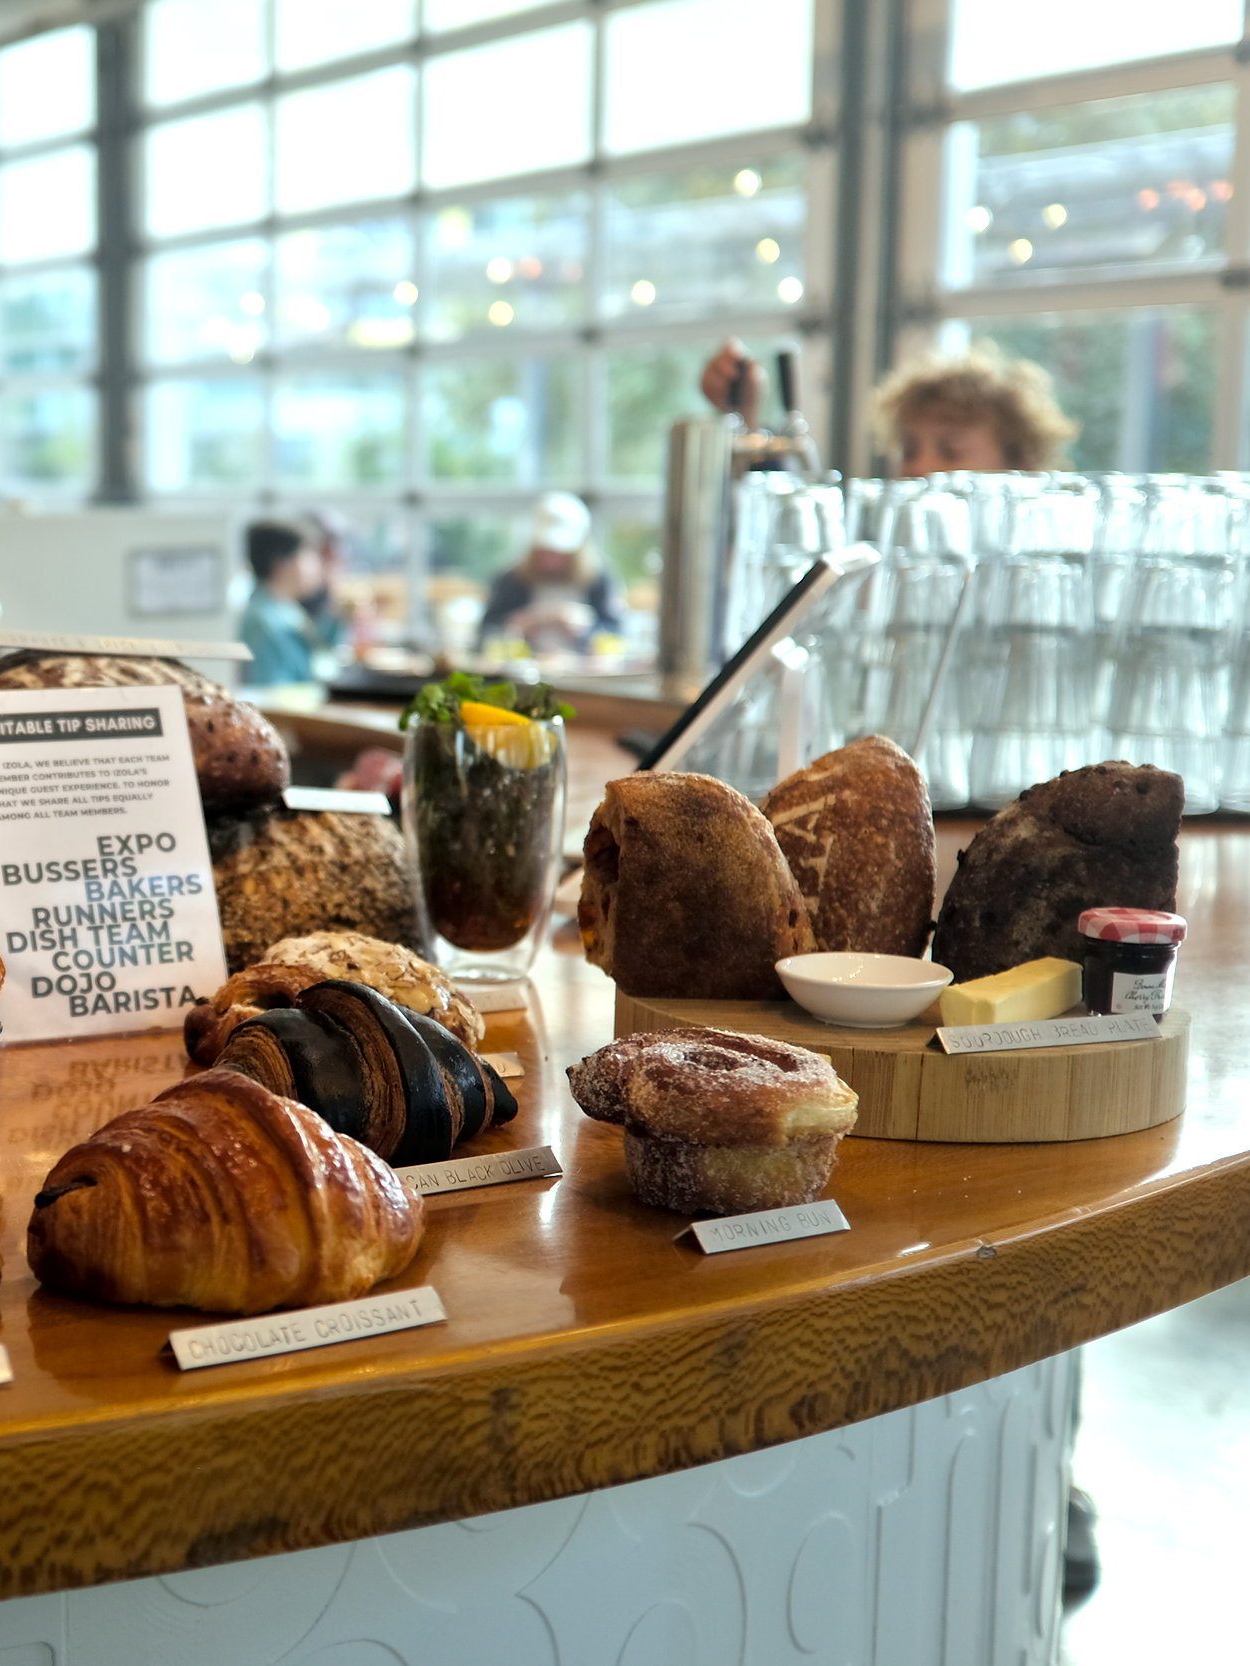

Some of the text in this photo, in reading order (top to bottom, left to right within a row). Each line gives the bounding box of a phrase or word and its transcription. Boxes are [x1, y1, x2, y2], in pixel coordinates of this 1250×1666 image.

[56, 718, 82, 733] TIP
[85, 715, 156, 732] SHARING
[35, 760, 51, 768] WE
[53, 758, 91, 767] BELIEVE
[92, 757, 116, 765] THAT
[118, 756, 143, 764] EACH
[145, 754, 170, 762] TEAM
[30, 785, 59, 794] GUEST
[123, 781, 135, 789] TO
[137, 779, 170, 788] HONOR
[32, 771, 96, 781] CONTRIBUTES
[20, 799, 36, 807] WE
[39, 797, 69, 806] SHARE
[72, 796, 88, 804] ALL
[90, 795, 111, 803] TIPS
[112, 793, 154, 803] EQUALLY
[33, 811, 50, 819] ALL
[53, 809, 78, 818] TEAM
[80, 807, 128, 816] MEMBERS.
[96, 832, 176, 857] EXPO
[1, 857, 137, 886] BUSSERS
[84, 873, 202, 903] BAKERS
[32, 898, 174, 929] RUNNERS
[6, 921, 171, 954] DISH TEAM
[52, 941, 194, 972] COUNTER
[31, 971, 116, 998] DOJO
[69, 985, 198, 1018] BARISTA
[446, 1164, 493, 1185] BLACK
[501, 1156, 546, 1175] OLIVE
[709, 1211, 833, 1241] MORNING BUN
[187, 1299, 425, 1360] CHOCOLATE CROISSANT
